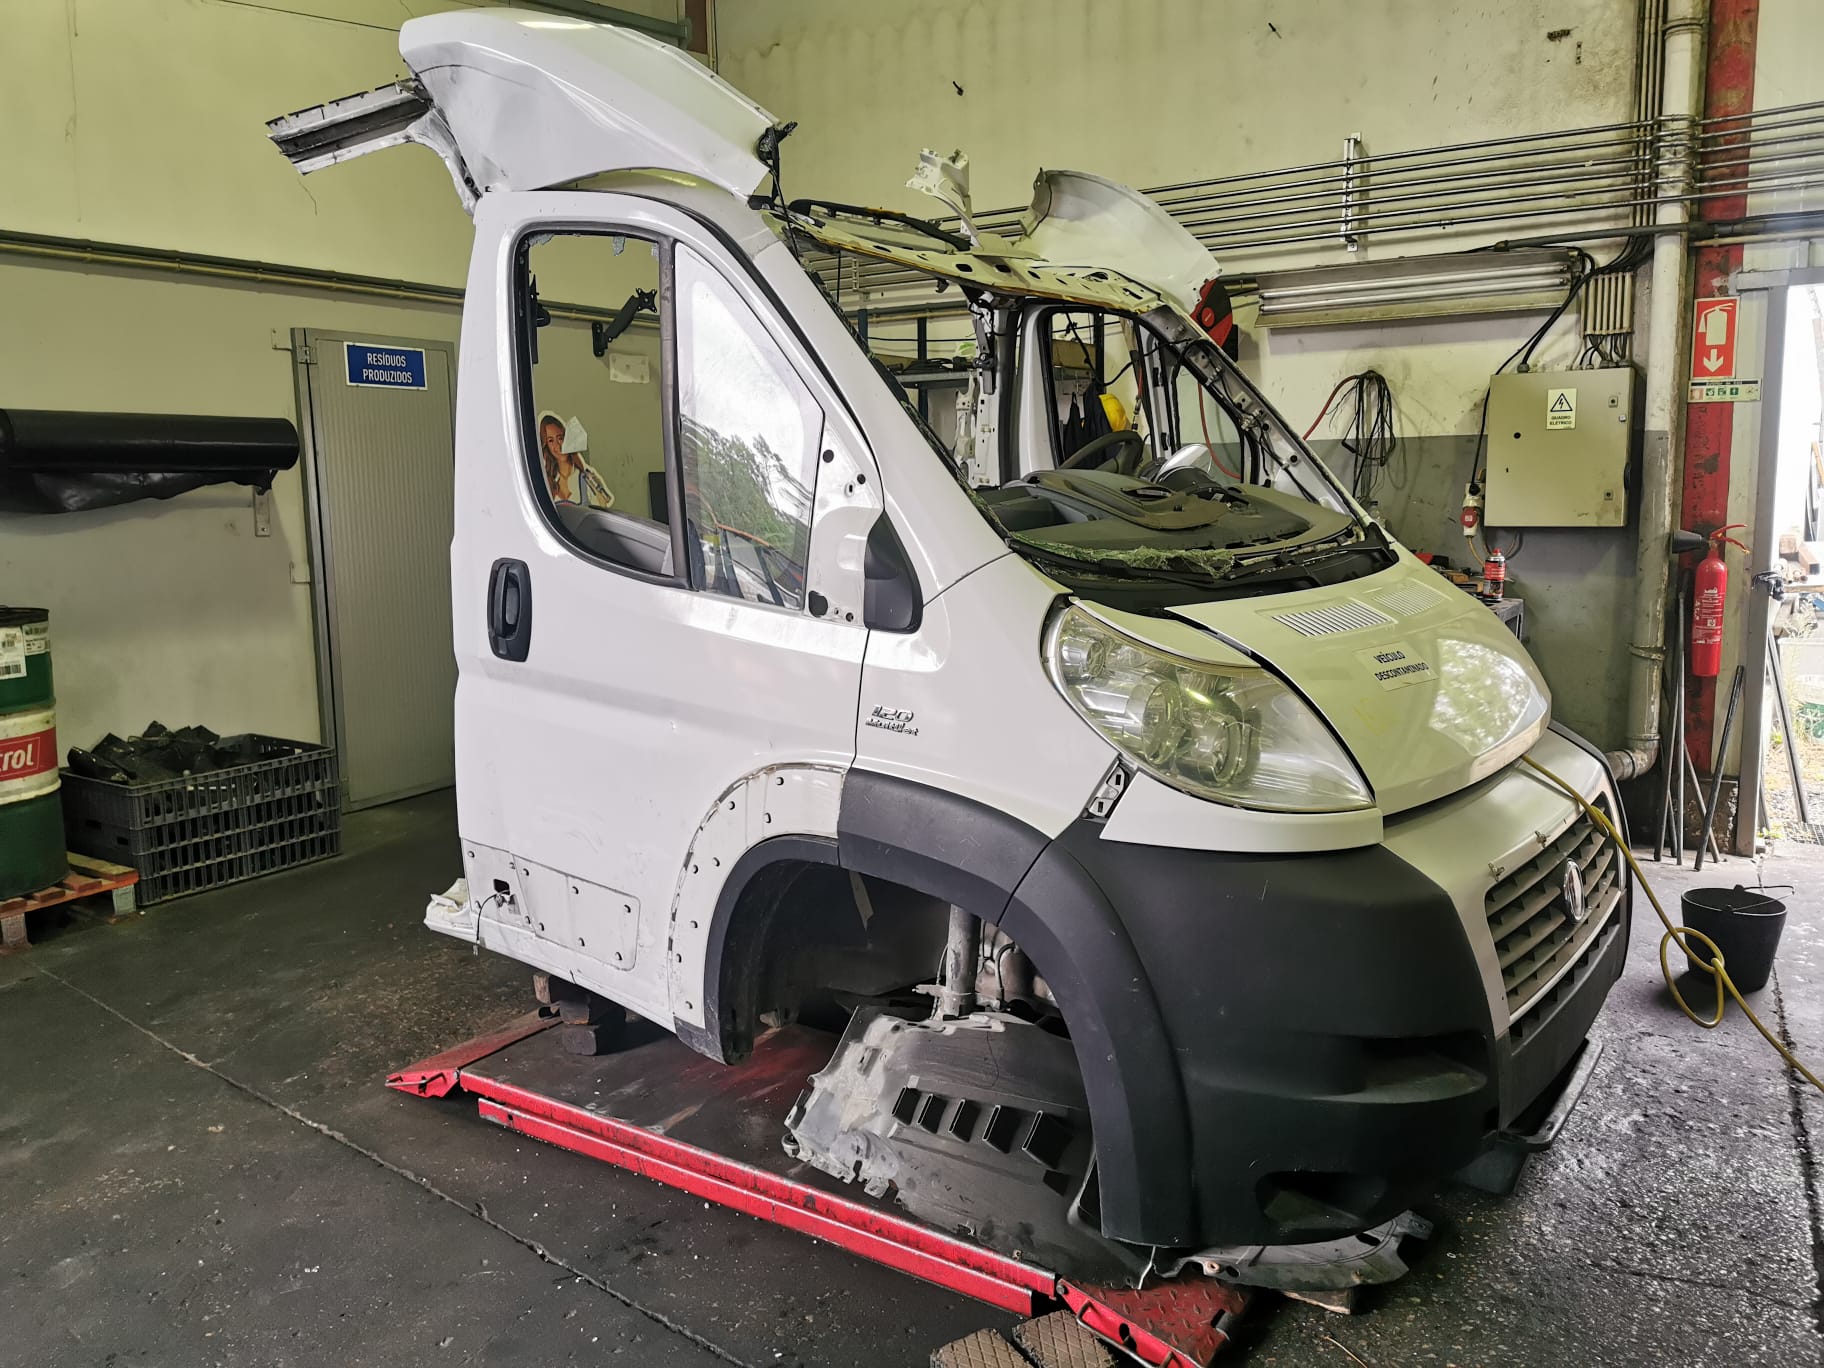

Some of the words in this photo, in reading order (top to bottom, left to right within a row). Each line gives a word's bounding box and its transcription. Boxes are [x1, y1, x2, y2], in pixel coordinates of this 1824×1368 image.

[367, 352, 406, 368] RESÍDUOS
[362, 369, 413, 384] PRODUZIDOS
[1374, 662, 1430, 681] DESCONTAMINADO
[871, 704, 915, 723] 120
